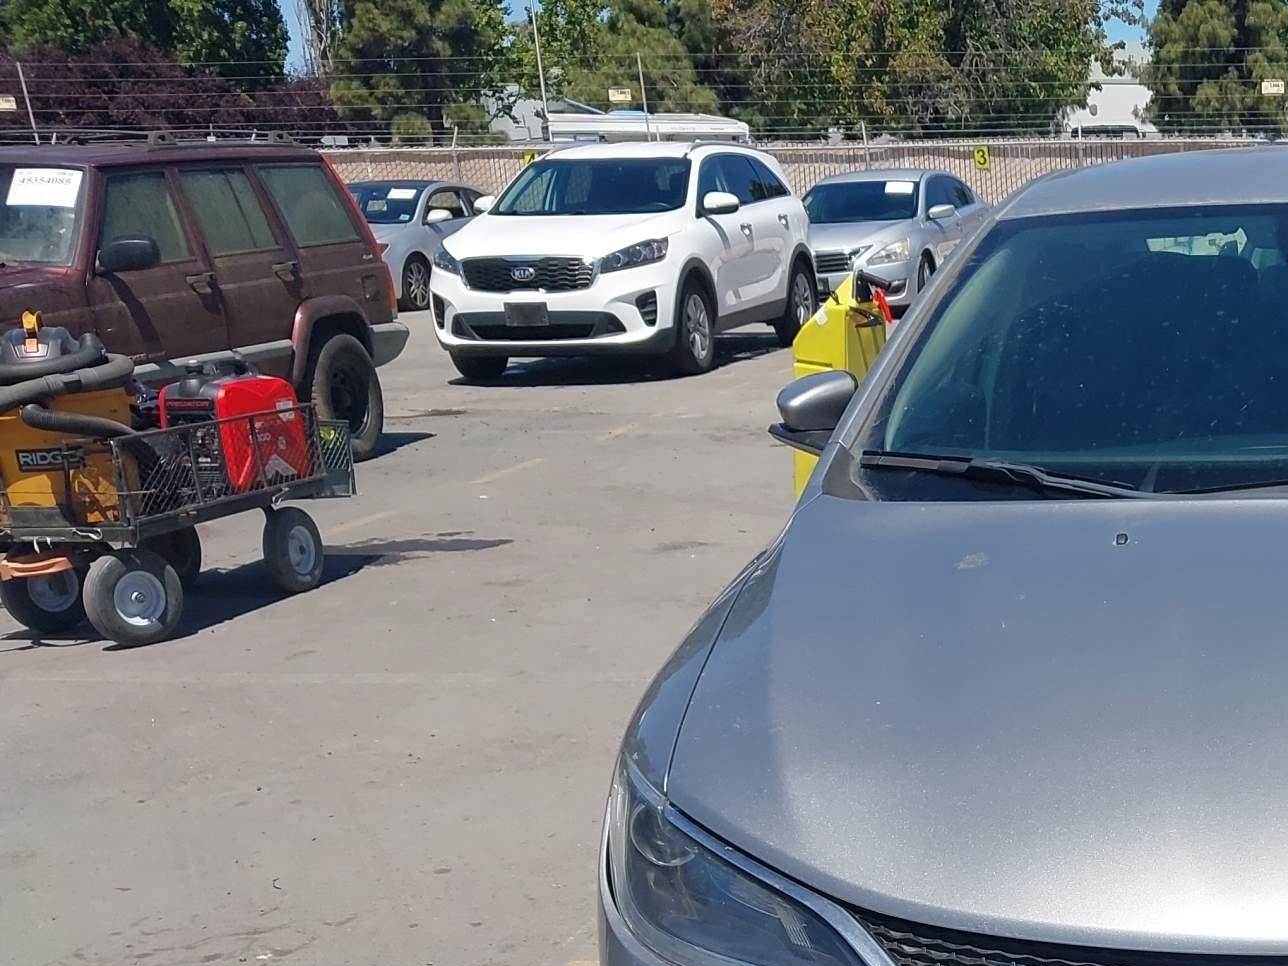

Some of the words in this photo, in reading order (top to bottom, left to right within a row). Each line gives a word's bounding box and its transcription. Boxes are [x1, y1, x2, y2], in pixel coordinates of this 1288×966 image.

[976, 149, 987, 166] 3
[514, 269, 532, 279] KIA
[19, 451, 80, 465] RIDG
